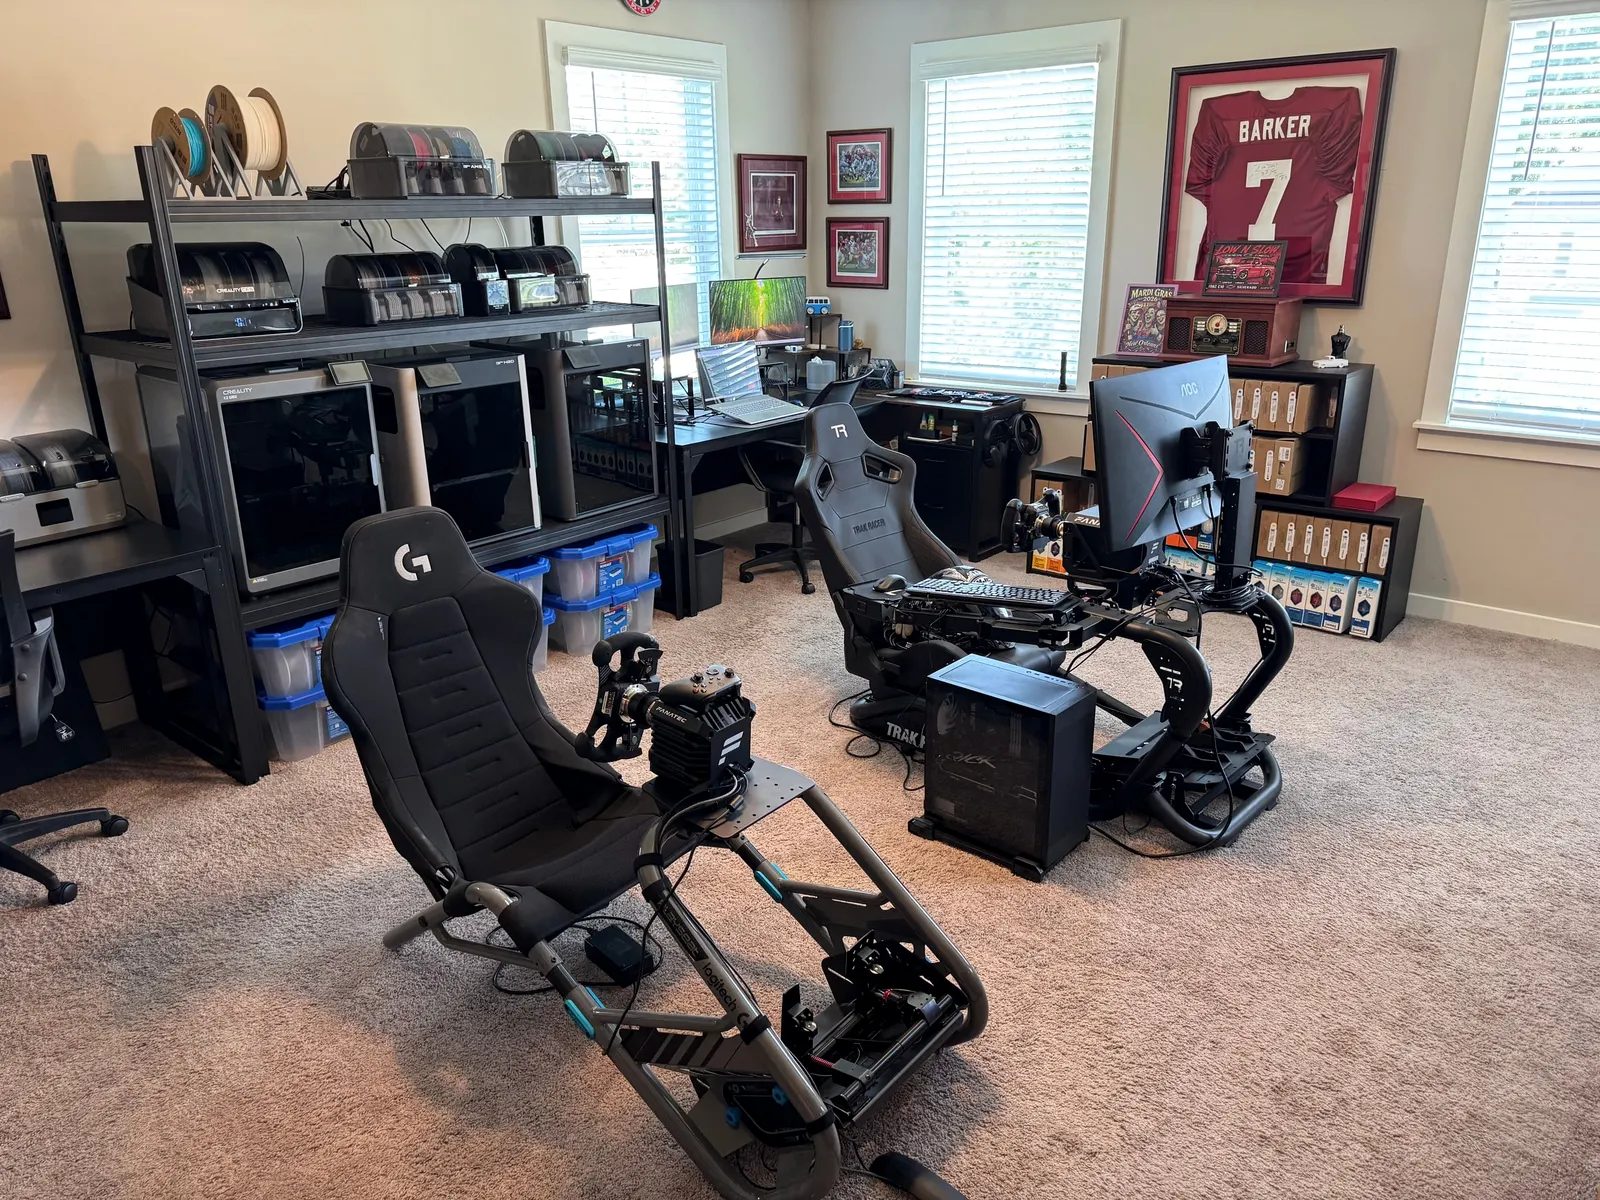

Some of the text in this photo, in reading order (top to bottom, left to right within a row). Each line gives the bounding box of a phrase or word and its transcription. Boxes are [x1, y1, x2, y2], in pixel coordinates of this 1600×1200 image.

[1239, 115, 1311, 142] BARKER
[1245, 159, 1293, 241] 7
[1215, 245, 1241, 255] LOW
[1241, 245, 1252, 253] N
[1252, 245, 1280, 254] SLOW
[1131, 288, 1173, 298] MARDI GRAS
[222, 387, 253, 396] CREALITY
[1180, 382, 1198, 397] AOC
[852, 518, 886, 535] TRAK RACER
[655, 706, 688, 724] FANATEC
[886, 721, 919, 746] TRAK
[702, 962, 738, 1012] logitech
